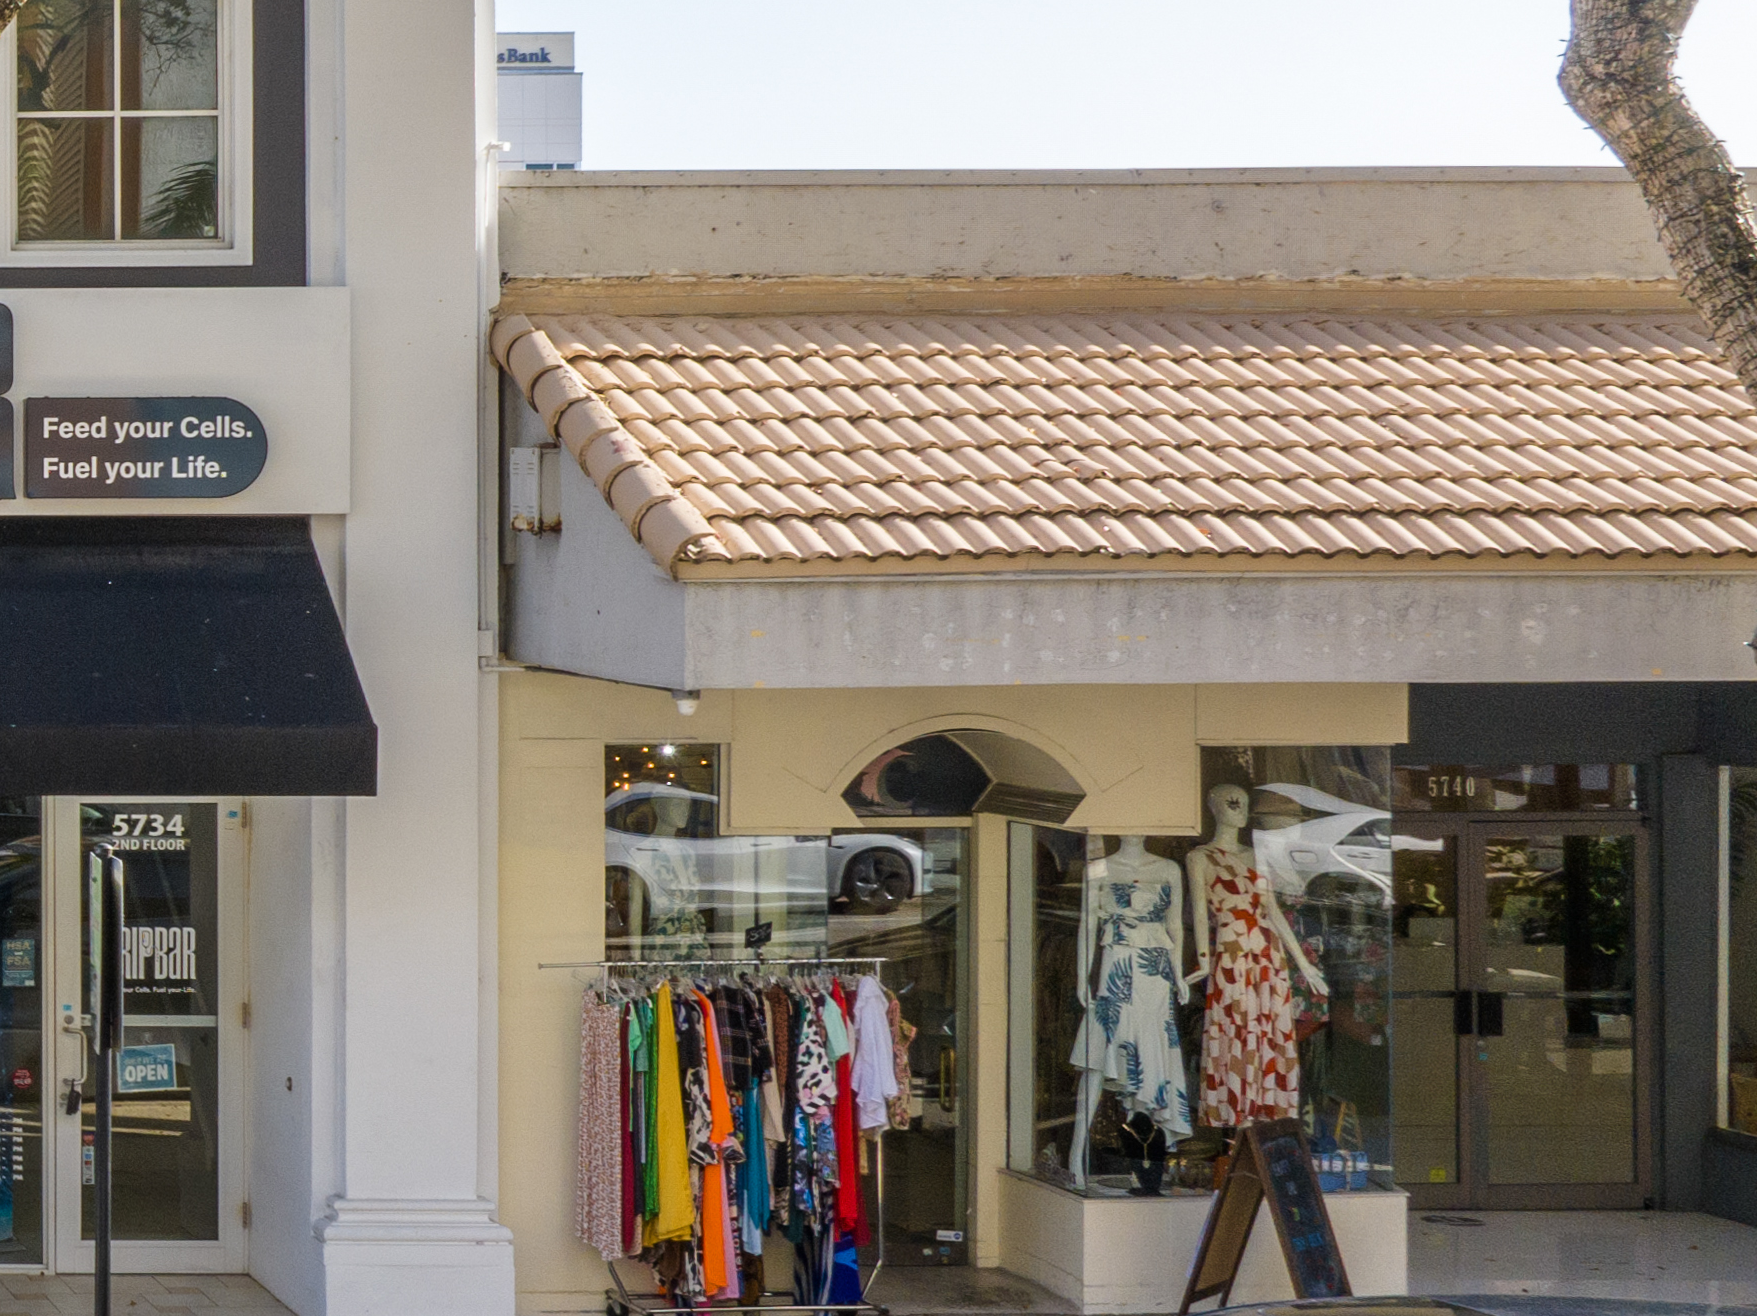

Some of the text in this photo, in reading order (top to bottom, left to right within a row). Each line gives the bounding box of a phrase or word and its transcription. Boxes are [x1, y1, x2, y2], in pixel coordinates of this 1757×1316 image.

[43, 416, 253, 444] Feed your Cells.
[43, 456, 227, 484] Fuel your Life.
[1428, 775, 1476, 798] 5740
[112, 814, 185, 836] 5734
[112, 839, 185, 851] 2ND FLOOR
[124, 1064, 169, 1083] OPEN
